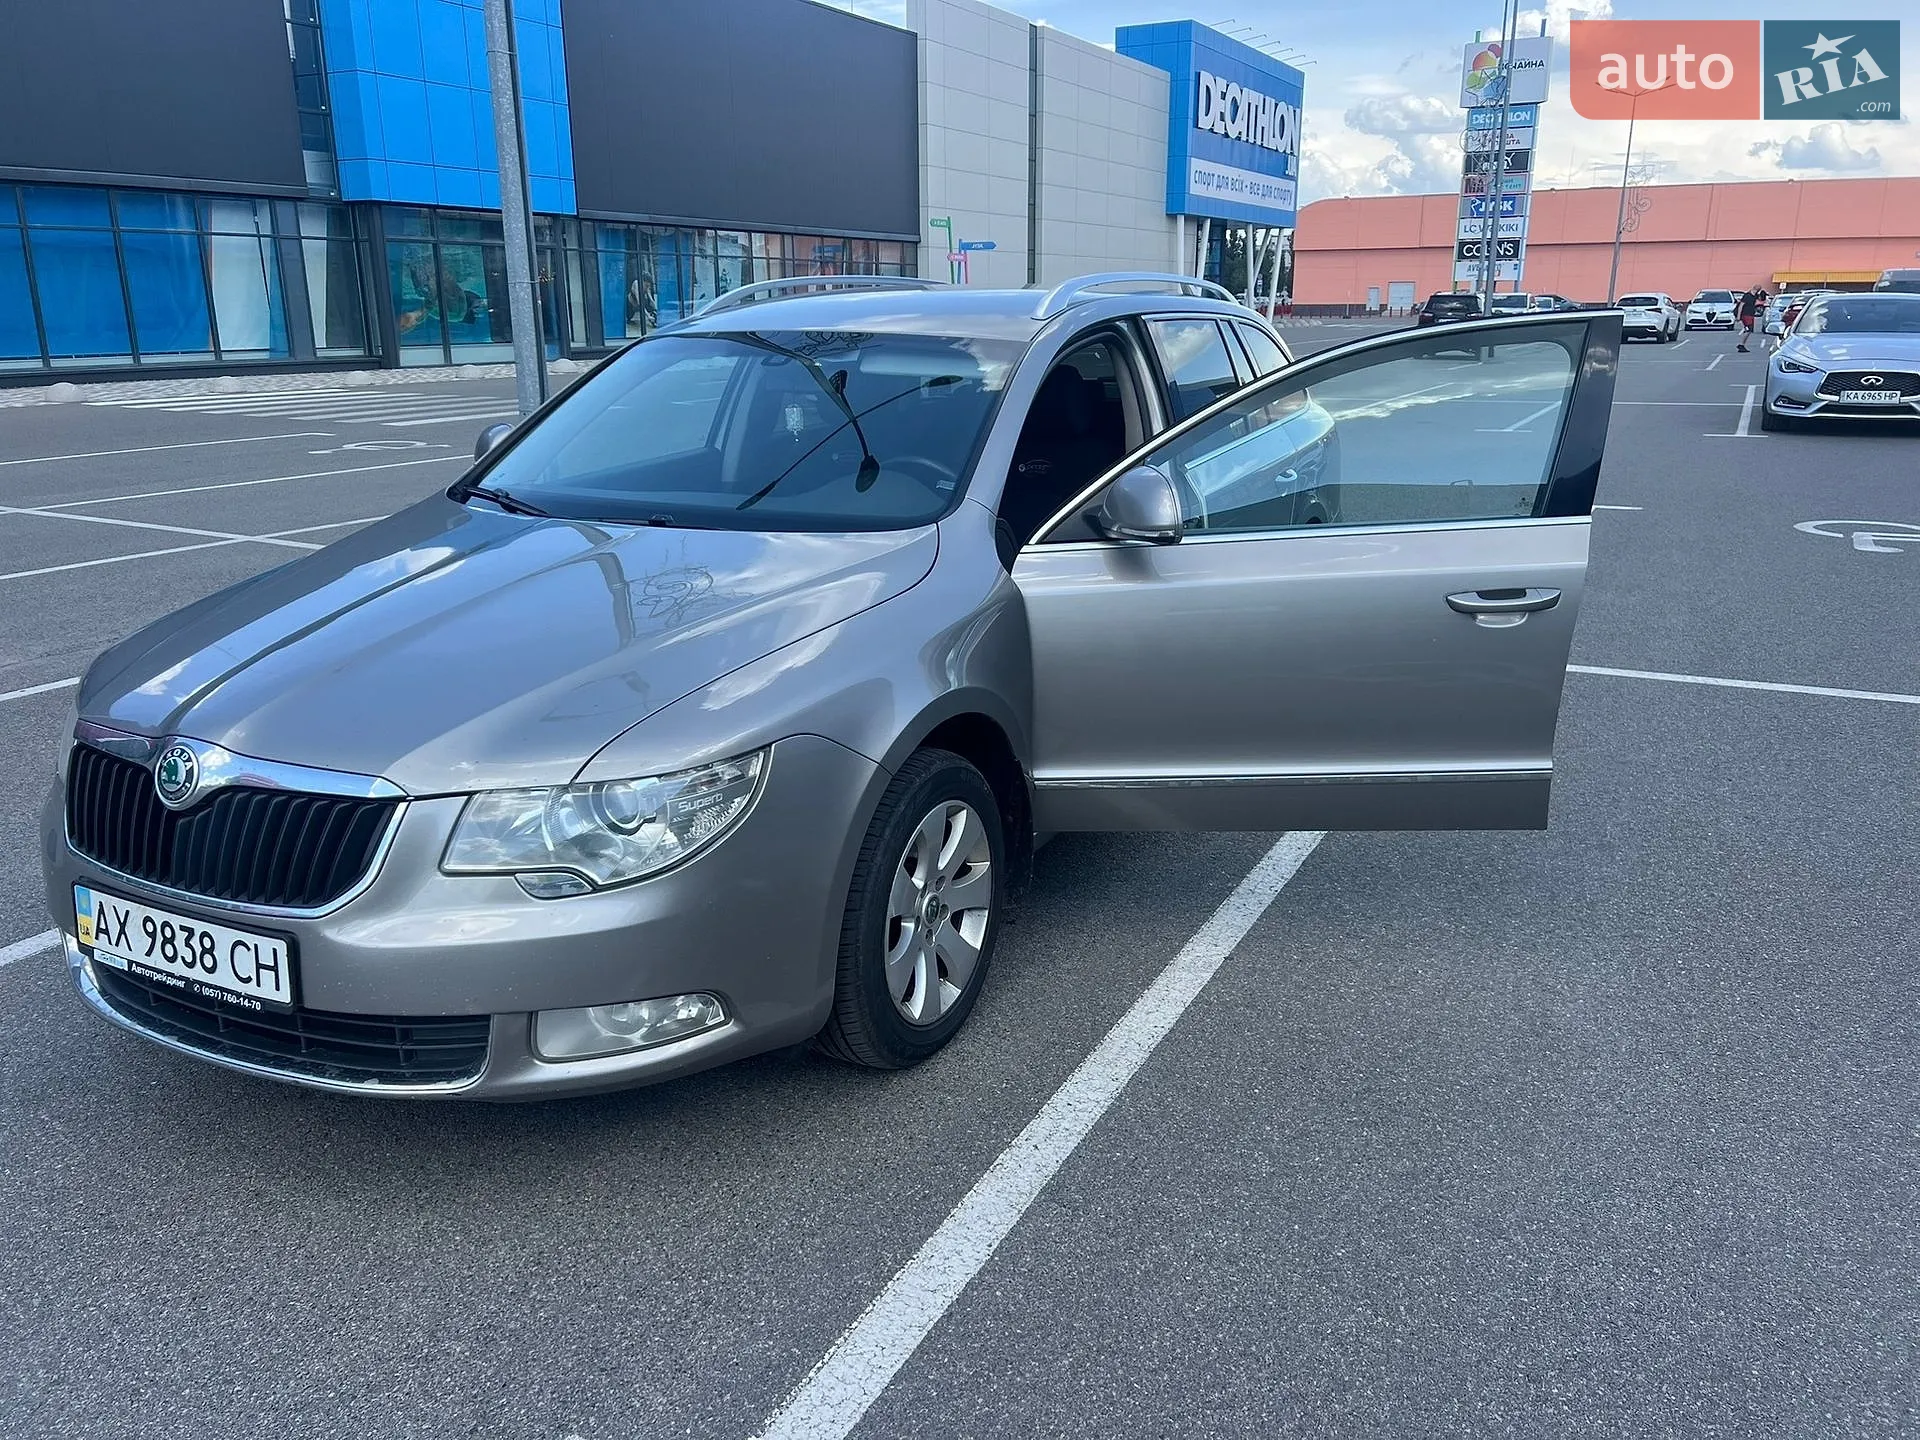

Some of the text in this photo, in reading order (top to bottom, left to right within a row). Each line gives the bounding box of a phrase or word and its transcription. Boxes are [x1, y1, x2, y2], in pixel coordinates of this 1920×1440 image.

[1198, 70, 1300, 156] DECATHLON
[1194, 169, 1215, 191] спорт
[1216, 174, 1229, 191] для
[1231, 174, 1244, 193] всіх
[1249, 181, 1260, 195] все
[1846, 392, 1898, 400] KA 6965 HP
[678, 793, 723, 812] Superb
[79, 923, 91, 937] UA
[95, 900, 281, 992] AX 9838 CH
[130, 962, 262, 1011] Автотрейдинг (057) 760-14-70
